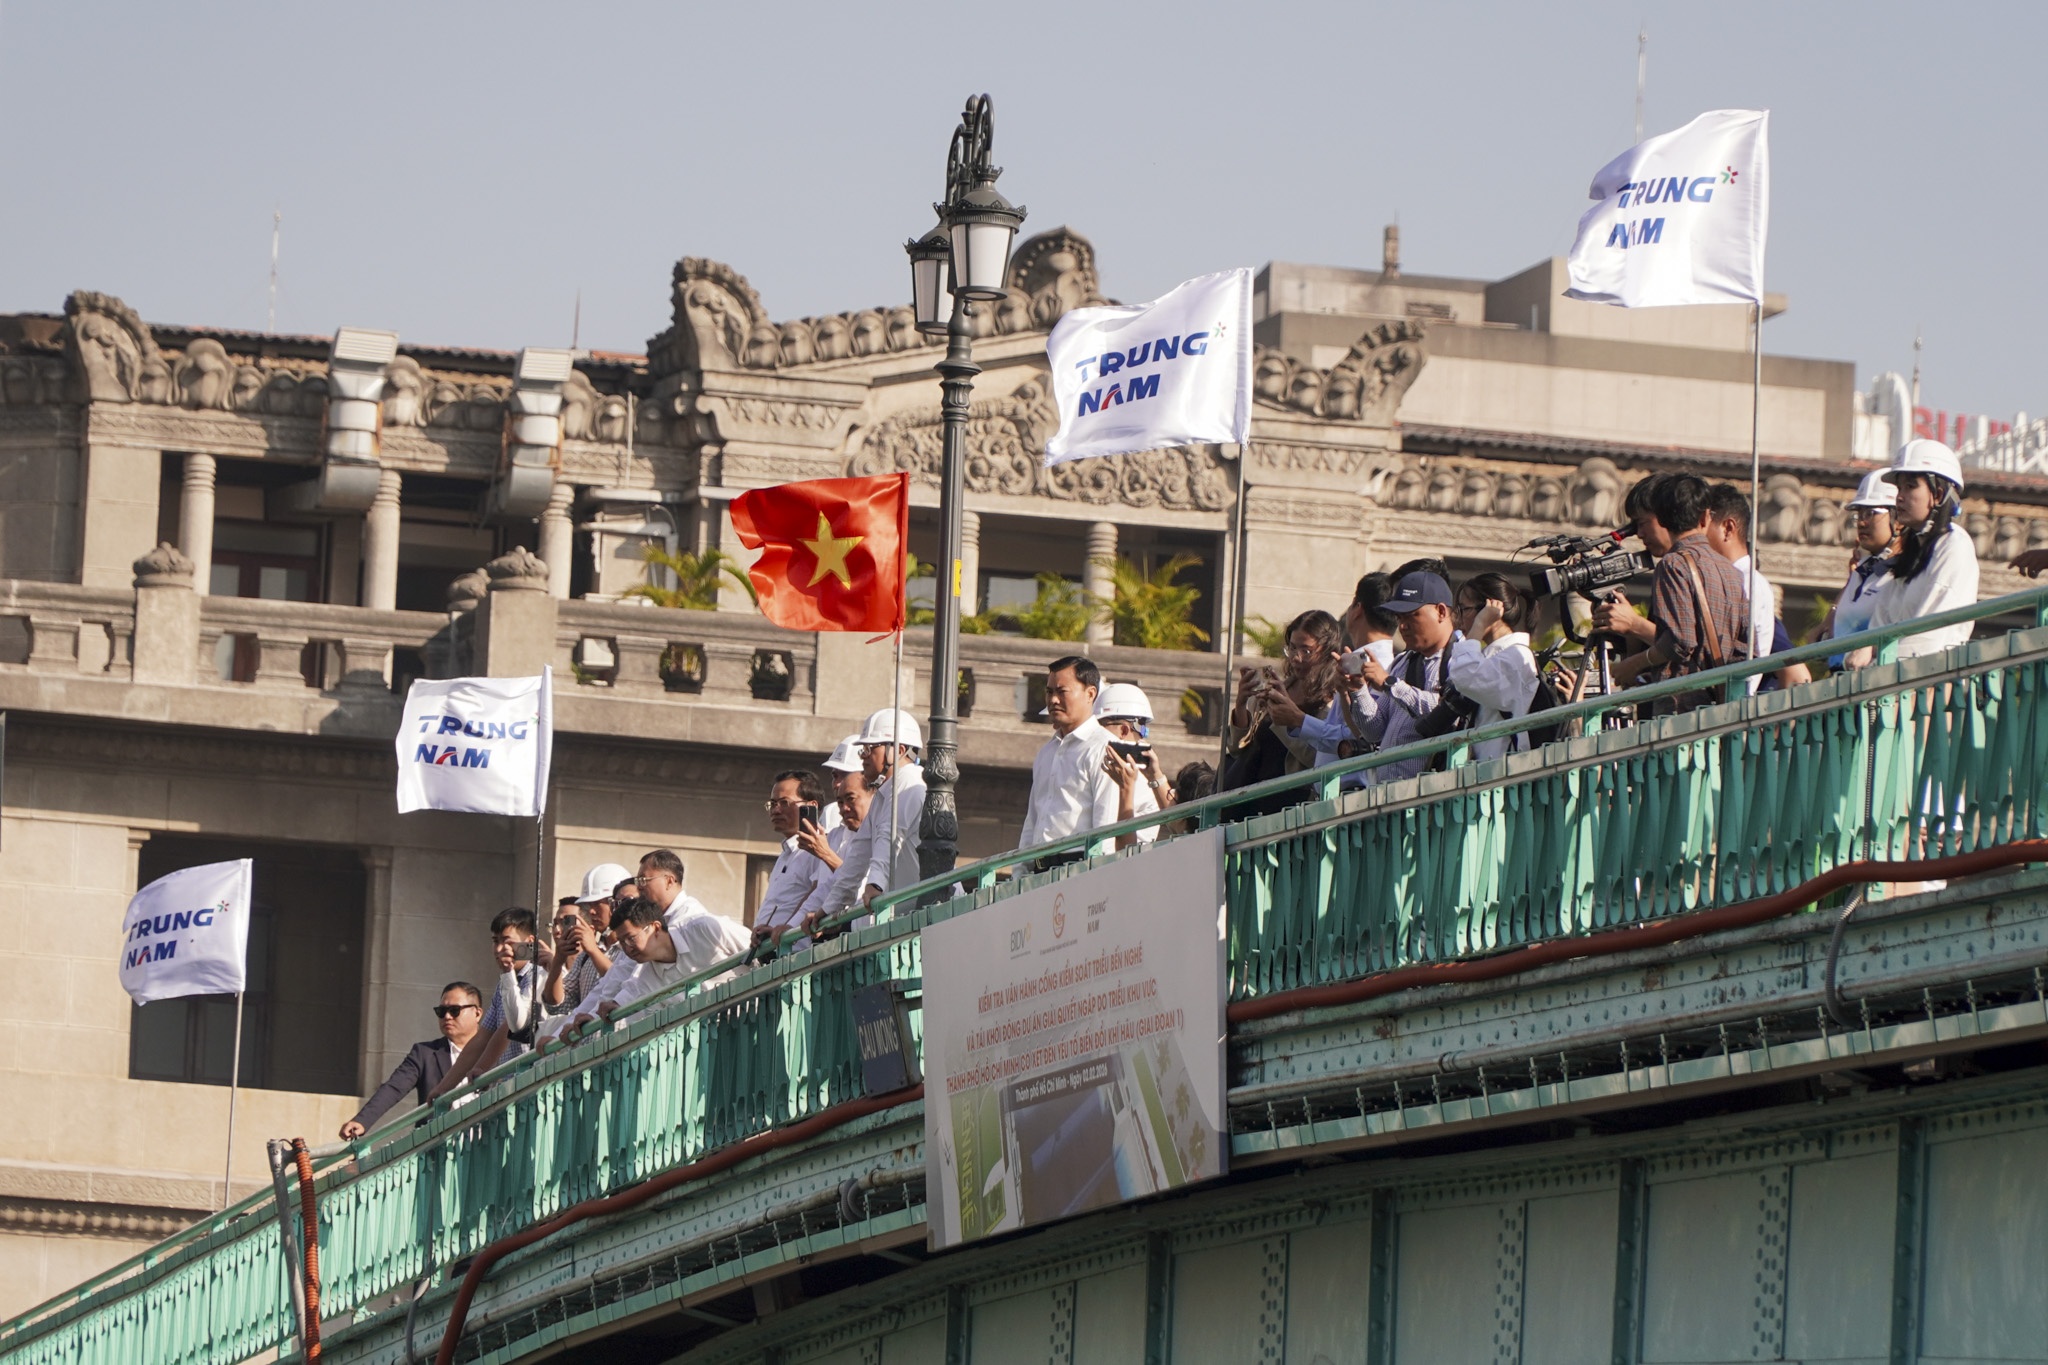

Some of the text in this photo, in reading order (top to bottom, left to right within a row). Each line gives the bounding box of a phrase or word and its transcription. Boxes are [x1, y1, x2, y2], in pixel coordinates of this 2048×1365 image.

[1617, 176, 1717, 209] TRUNG
[1075, 331, 1210, 383] TRUNG
[1078, 373, 1161, 417] NAM
[418, 715, 528, 740] TRUNG
[414, 743, 492, 768] NAM
[128, 908, 214, 942] TRUNG
[1011, 928, 1026, 952] BIDV
[126, 940, 177, 970] NAM
